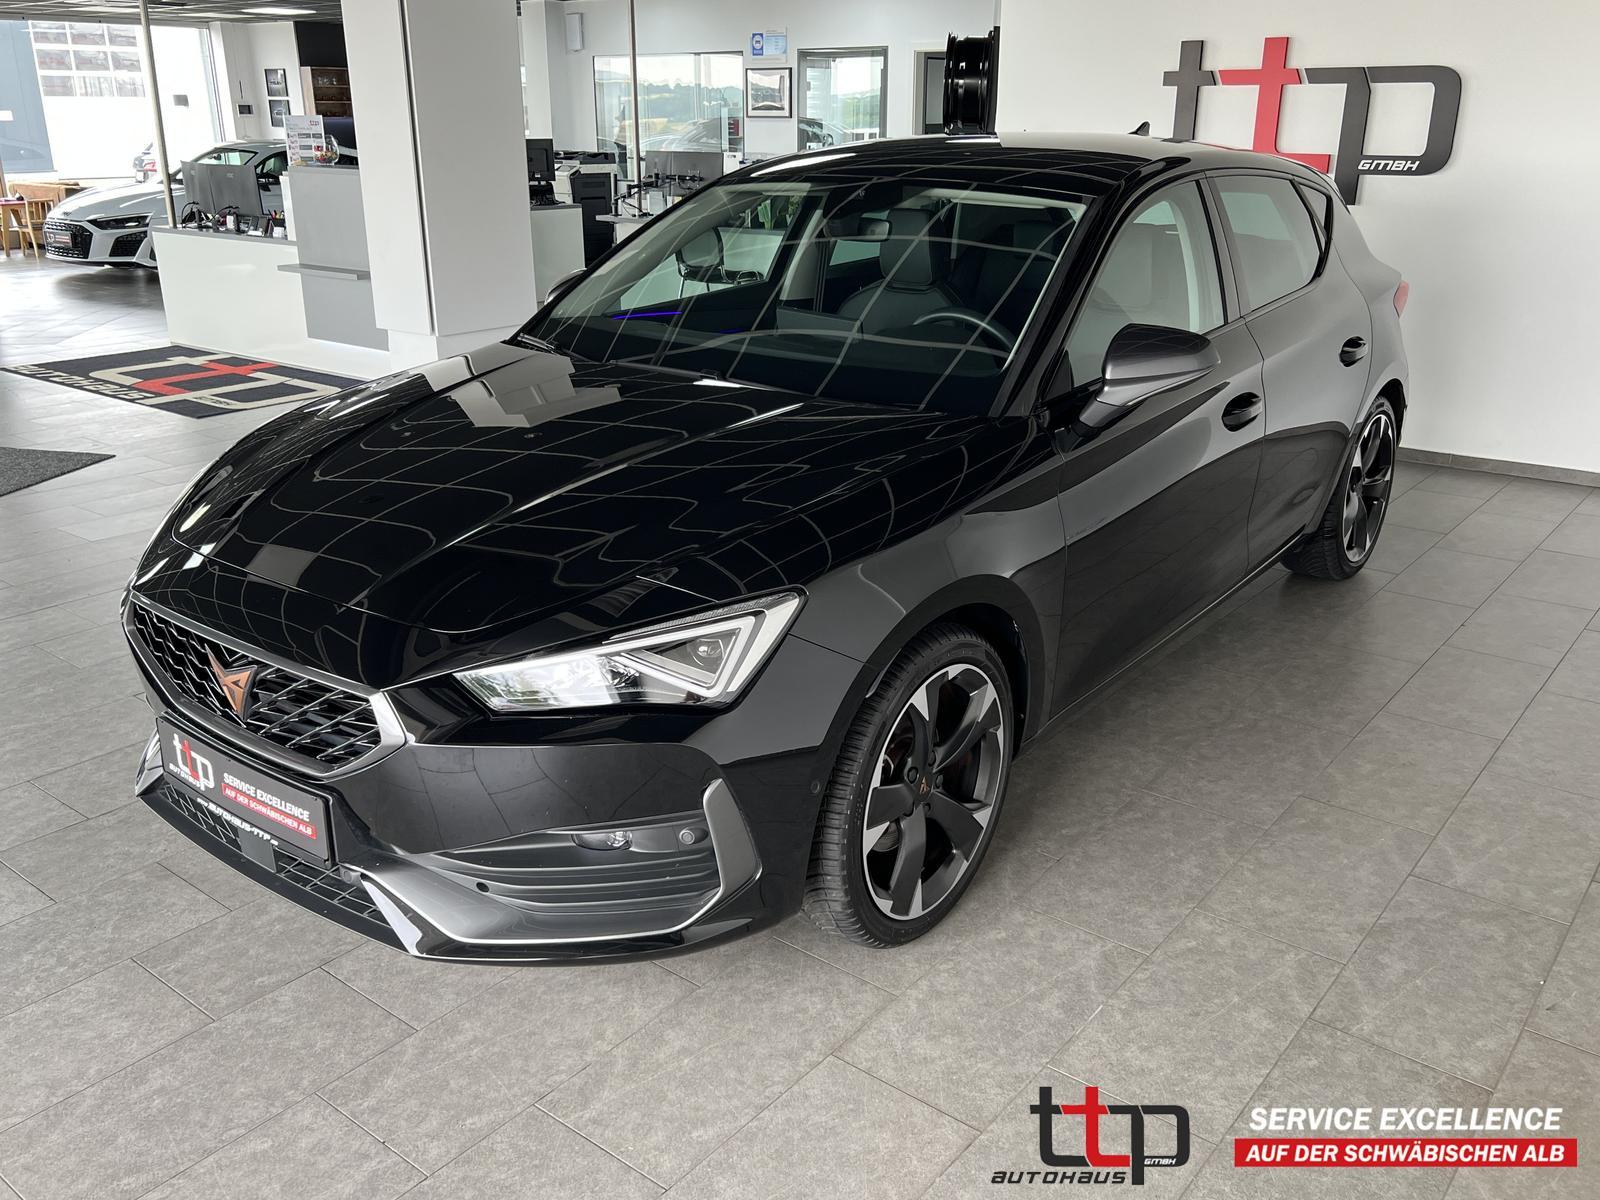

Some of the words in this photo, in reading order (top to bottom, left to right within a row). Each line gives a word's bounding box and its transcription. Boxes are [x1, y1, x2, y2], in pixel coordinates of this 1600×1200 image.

[1357, 160, 1420, 171] GMBH
[223, 772, 256, 797] SERVICE
[256, 789, 311, 822] EXCELLENCE
[225, 787, 236, 799] AUF
[236, 793, 249, 806] DER
[298, 823, 313, 836] ALB
